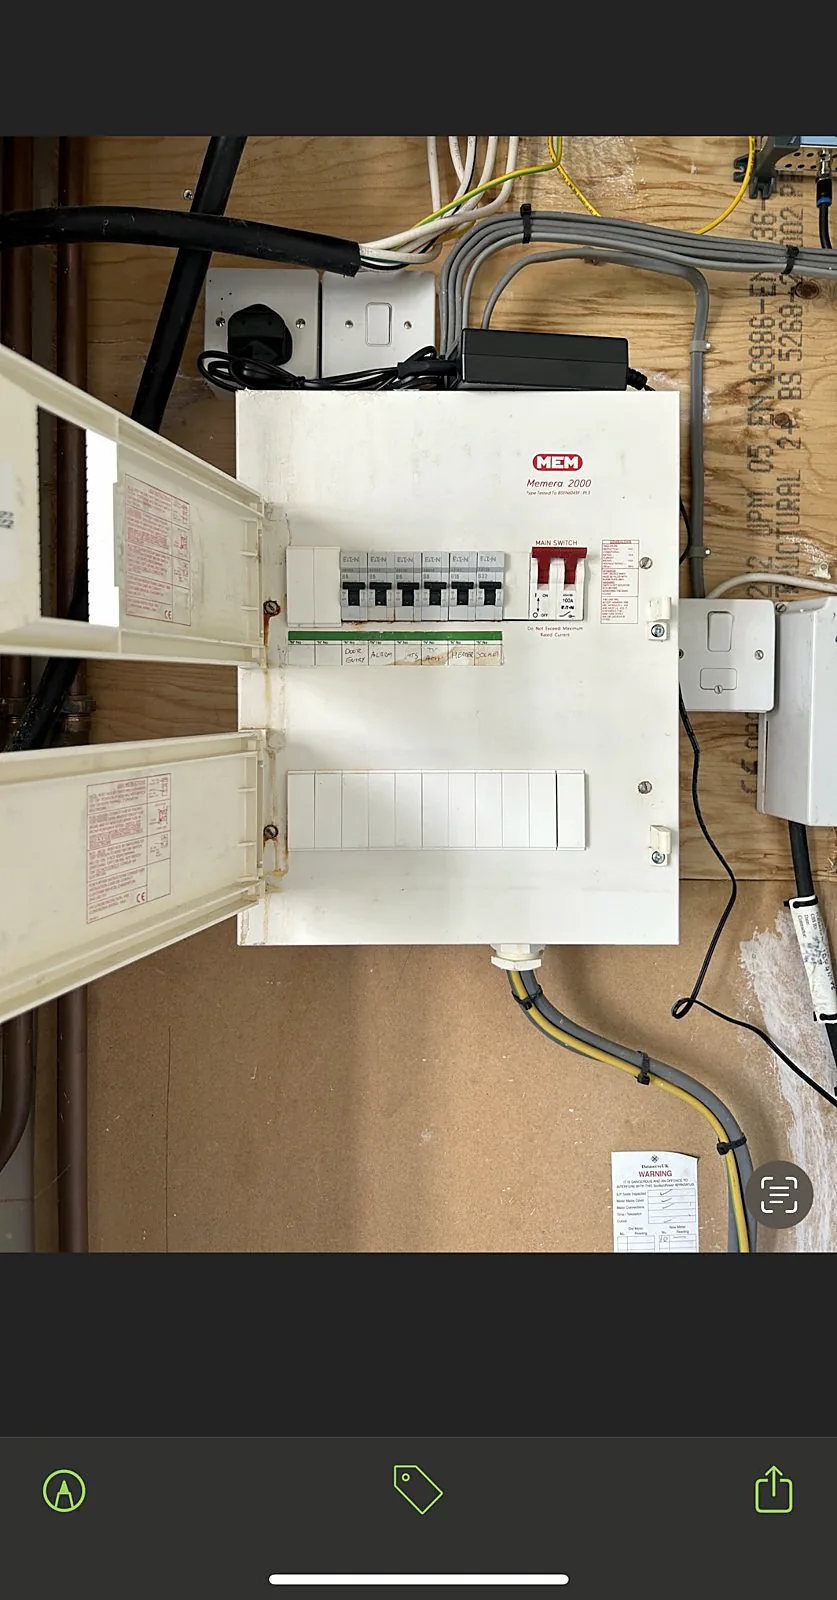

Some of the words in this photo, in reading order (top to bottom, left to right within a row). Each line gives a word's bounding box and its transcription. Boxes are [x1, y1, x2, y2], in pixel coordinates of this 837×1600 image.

[778, 371, 802, 400] BS
[747, 396, 775, 427] EN
[536, 456, 579, 469] MEM
[526, 479, 564, 488] Memera
[568, 479, 592, 488] 2000
[746, 491, 773, 537] UPM
